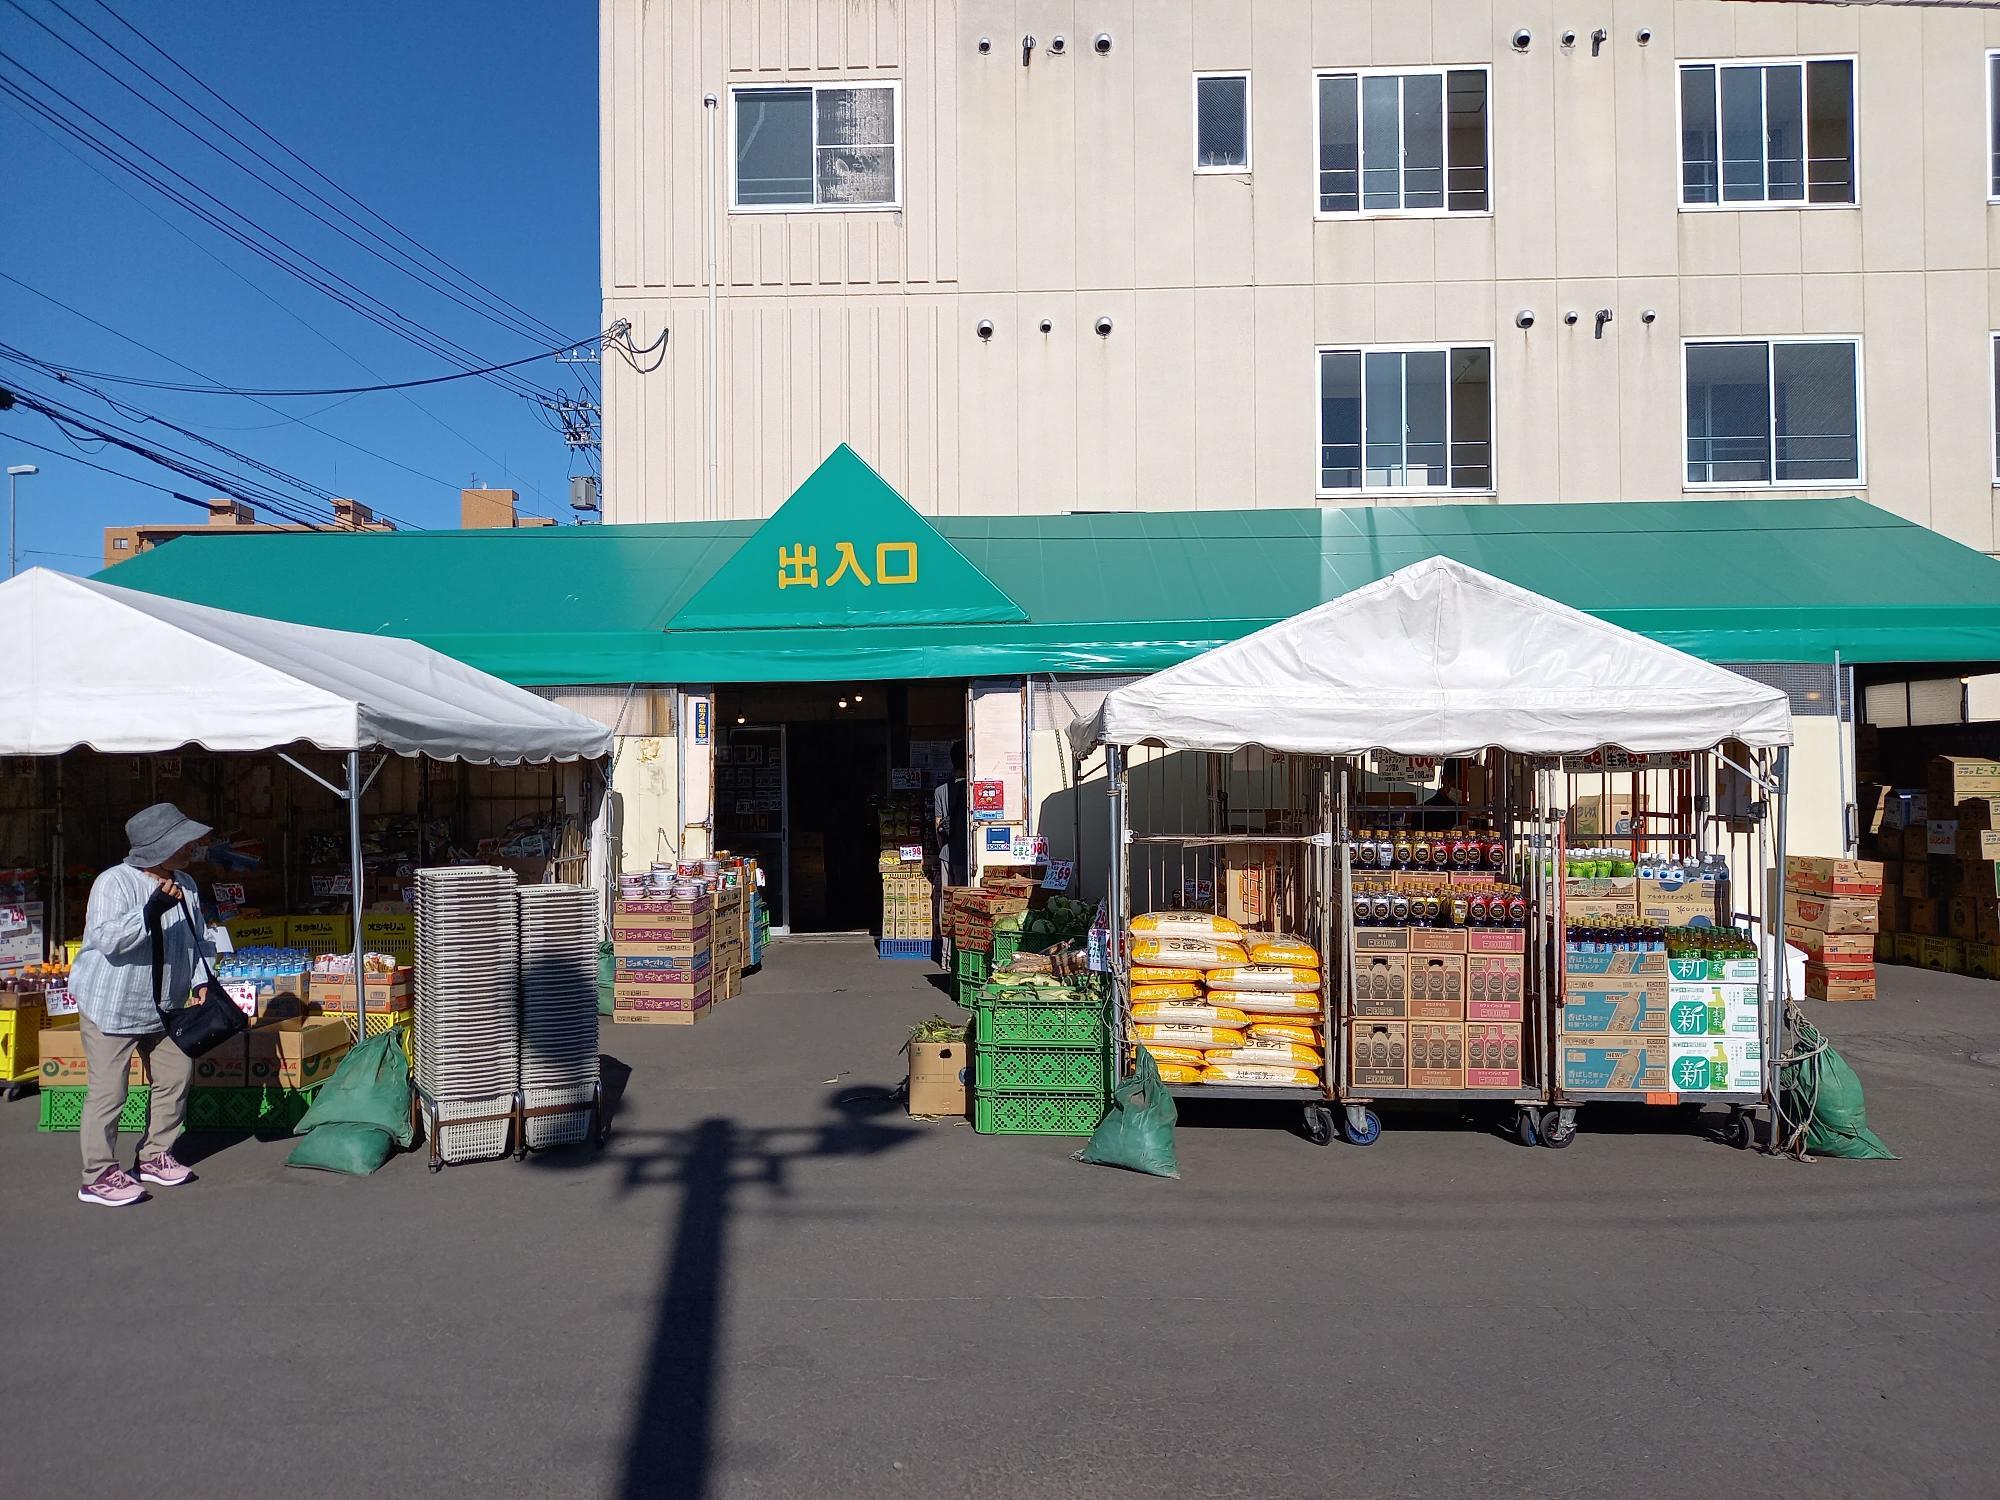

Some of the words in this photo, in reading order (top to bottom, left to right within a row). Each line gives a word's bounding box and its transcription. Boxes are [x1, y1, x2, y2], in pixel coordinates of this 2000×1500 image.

[778, 542, 918, 589] 出入口
[1606, 753, 1627, 767] 生茶
[1976, 766, 2000, 775] ピーマ
[911, 847, 921, 856] 98
[1012, 846, 1029, 857] とまと
[1057, 866, 1071, 880] 69
[228, 887, 243, 898] 98
[1647, 893, 1694, 902] アルカリイオンの水
[1677, 1004, 1705, 1033] 新
[1712, 1008, 1721, 1026] 生茶
[1680, 1060, 1707, 1087] 新
[1715, 1064, 1724, 1082] 生茶
